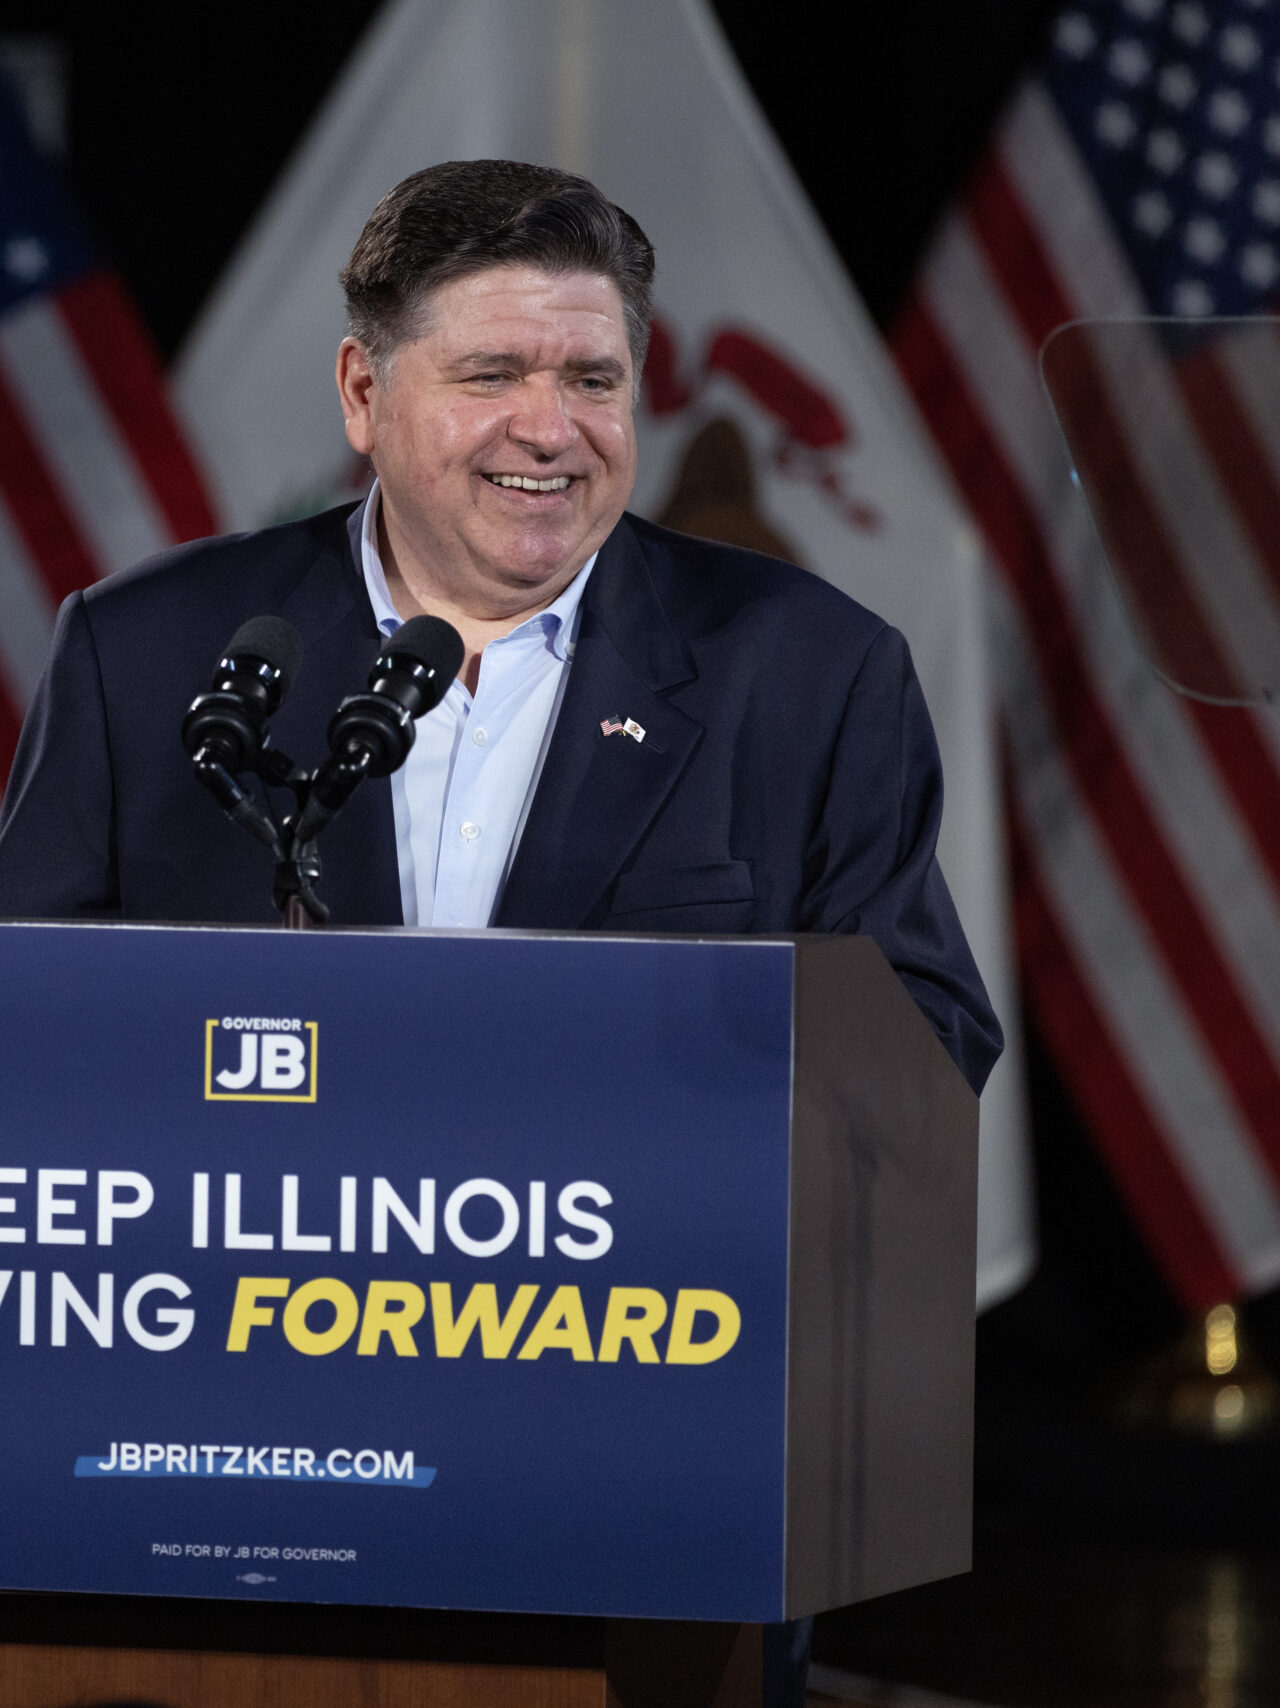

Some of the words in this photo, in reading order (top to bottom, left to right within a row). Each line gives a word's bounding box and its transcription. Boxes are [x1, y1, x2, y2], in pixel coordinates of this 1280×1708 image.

[221, 1016, 302, 1031] GOVERNOR
[215, 1033, 306, 1090] JB
[192, 1172, 614, 1261] ILLINOIS
[226, 1276, 742, 1365] FORWARD
[97, 1442, 415, 1480] JBPRITZKER.COM
[152, 1543, 182, 1557] PAID
[185, 1544, 211, 1557] FOR
[214, 1545, 232, 1558] BY
[233, 1546, 250, 1559] JB
[253, 1546, 279, 1559] FOR
[282, 1547, 357, 1562] GOVERNOR
